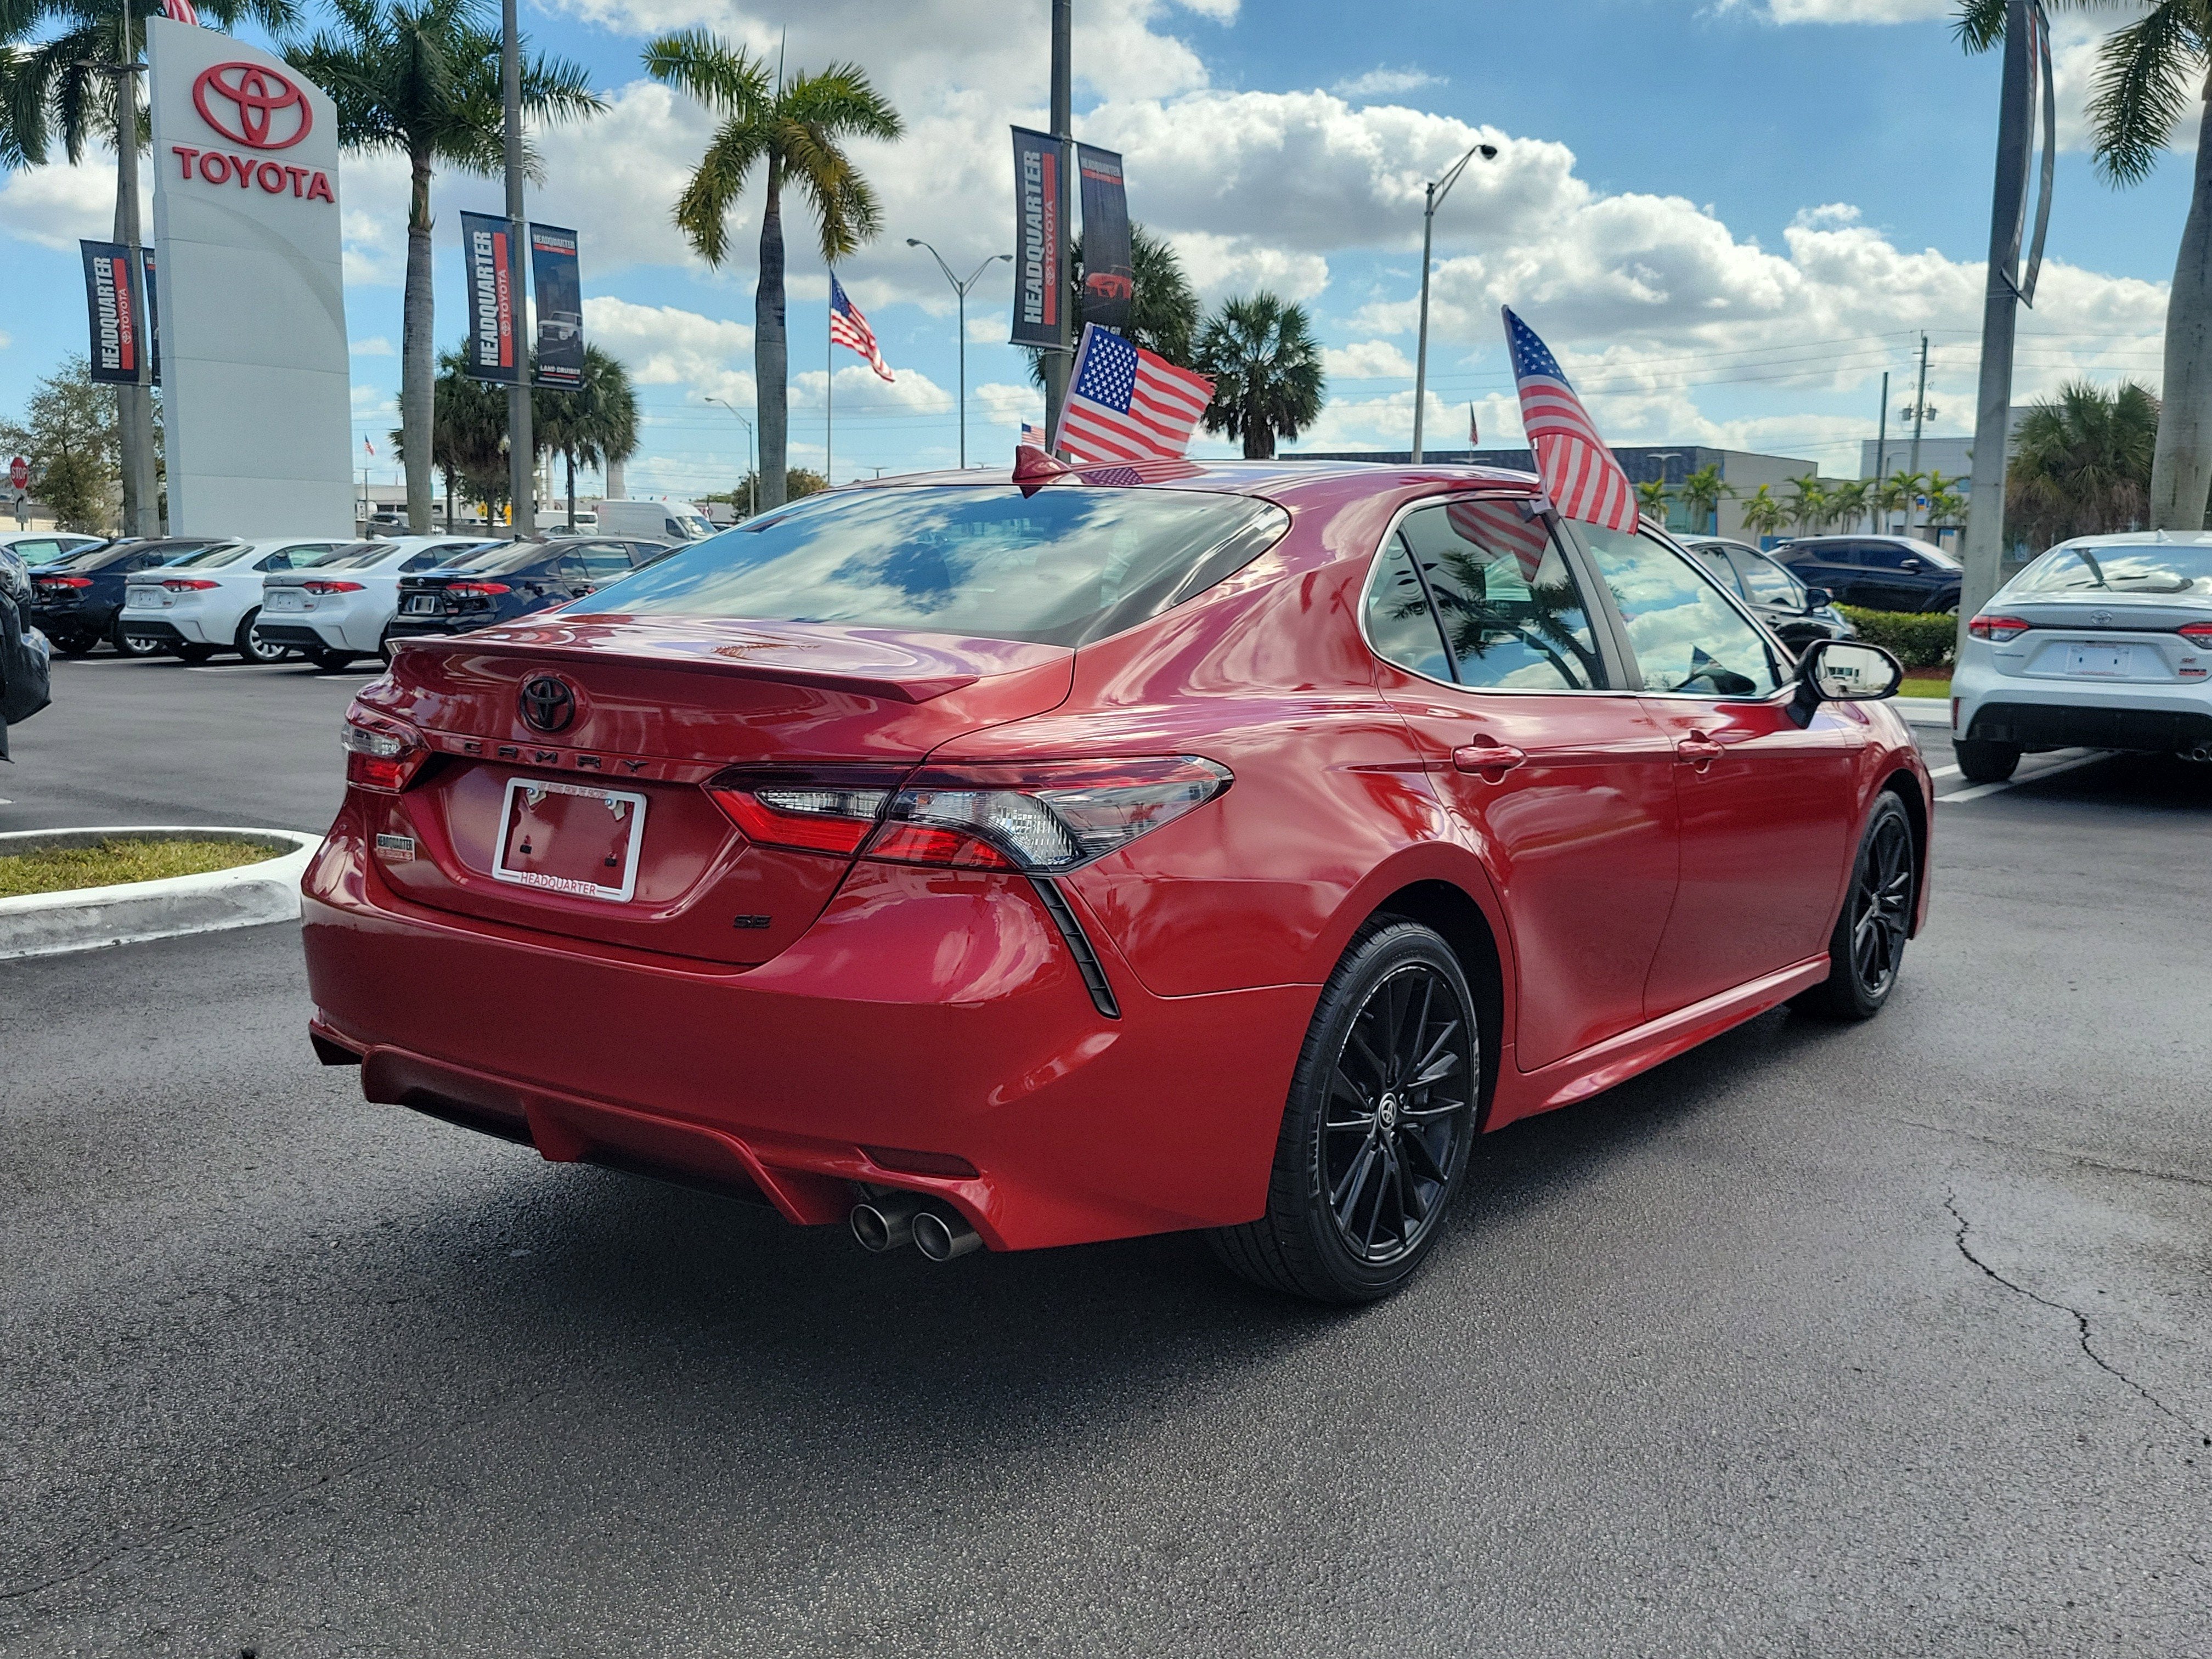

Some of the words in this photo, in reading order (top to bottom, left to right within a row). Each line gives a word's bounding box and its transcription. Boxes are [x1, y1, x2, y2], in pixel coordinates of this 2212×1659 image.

[172, 146, 335, 204] TOYOTA
[1023, 150, 1045, 324] HEADQUARTER
[1045, 200, 1054, 262] TOYOTA
[94, 257, 120, 370] HEADQUARTER
[119, 289, 132, 329] TOYOTA
[473, 230, 499, 366] HEADQUARTER
[498, 269, 510, 318] TOYOTA
[12, 466, 27, 479] STOP
[464, 742, 650, 772] CAMRY
[521, 873, 596, 895] HEADQUARTER
[733, 915, 772, 929] SE
